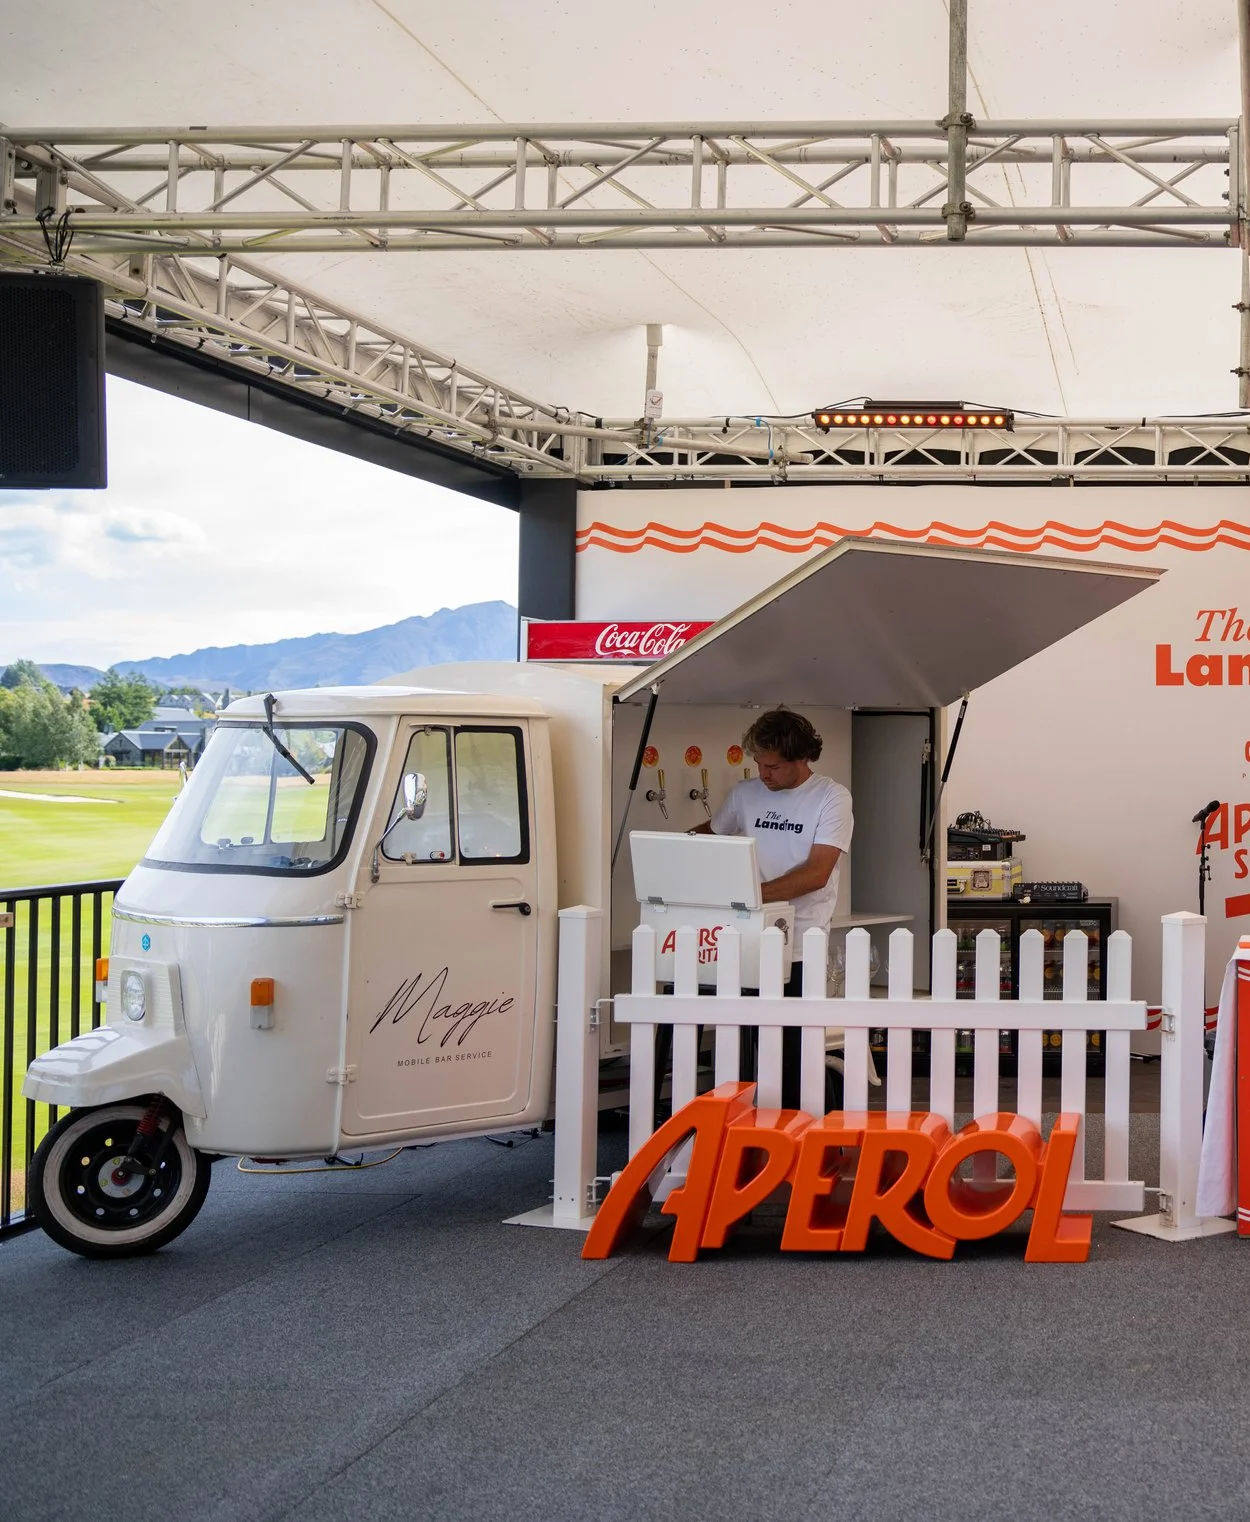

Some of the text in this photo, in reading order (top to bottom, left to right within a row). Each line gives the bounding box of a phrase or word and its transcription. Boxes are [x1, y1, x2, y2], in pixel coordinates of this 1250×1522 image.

[595, 624, 692, 656] Coca-Cola
[765, 810, 782, 821] The
[754, 818, 804, 834] Landing
[1040, 883, 1078, 892] Soundcraft
[369, 966, 515, 1048] Maggie
[397, 1051, 492, 1067] MOBILE BAR SERVICE
[581, 1081, 1094, 1263] APEROL
